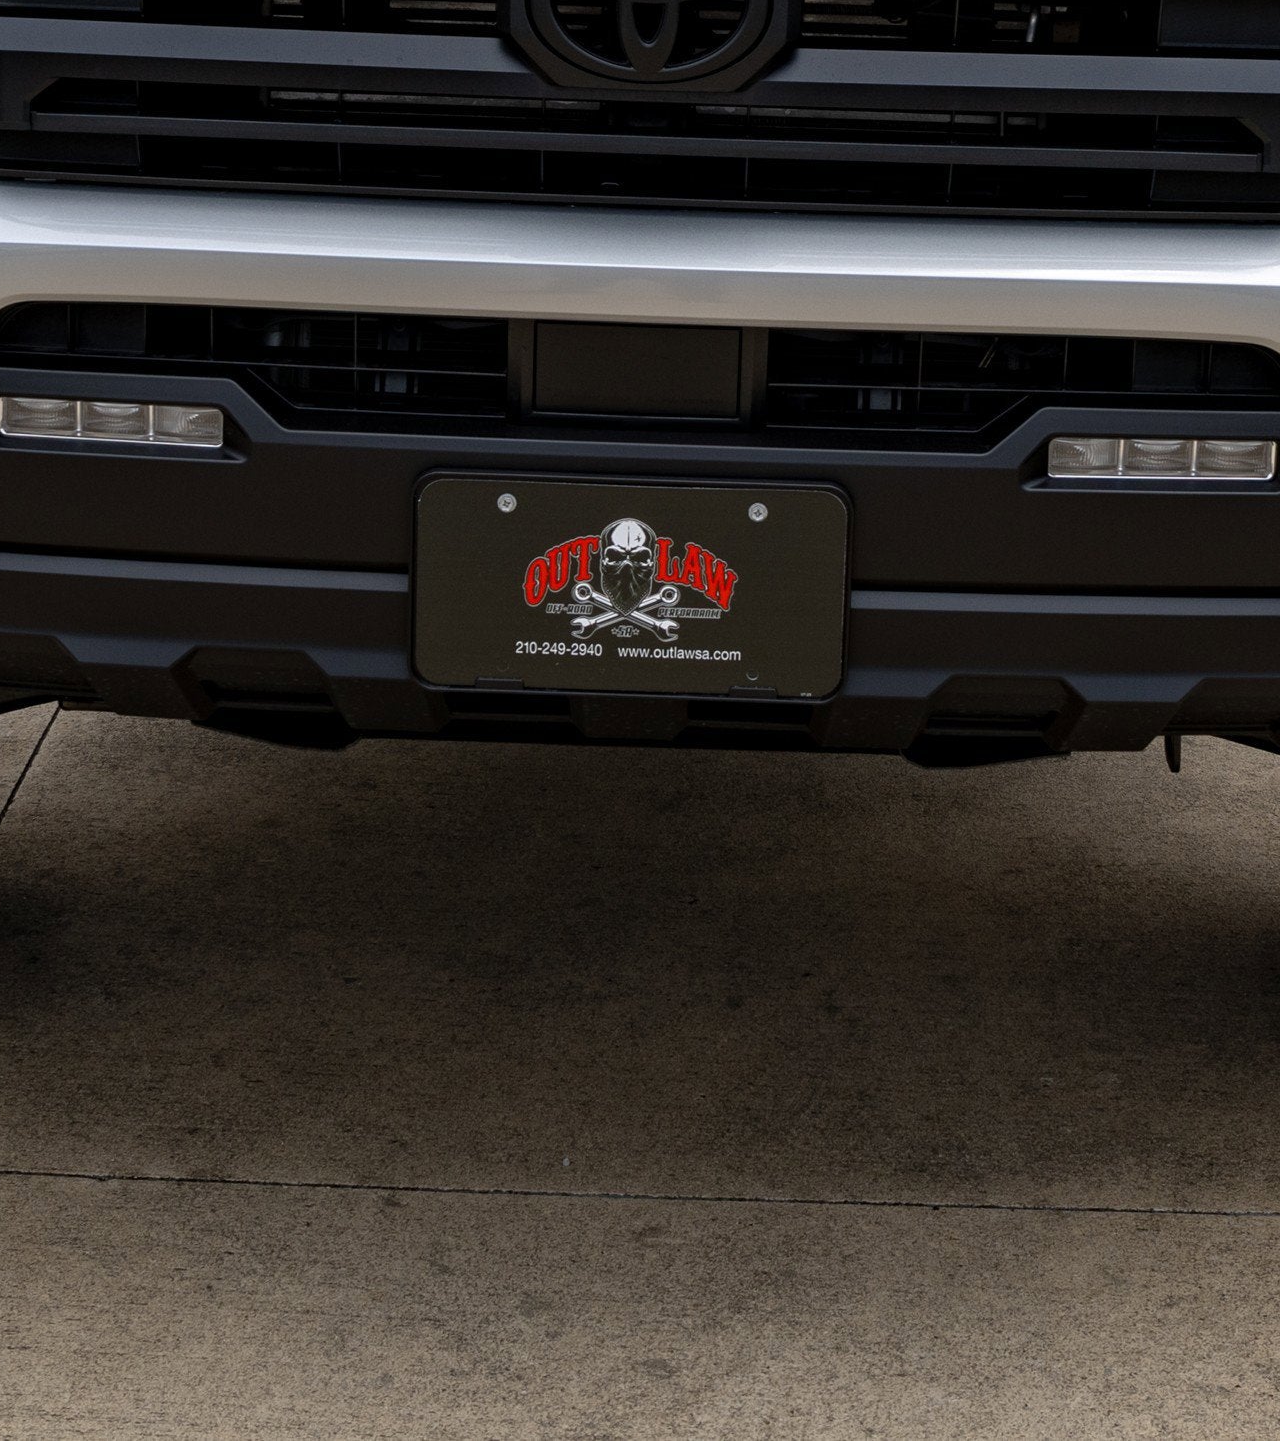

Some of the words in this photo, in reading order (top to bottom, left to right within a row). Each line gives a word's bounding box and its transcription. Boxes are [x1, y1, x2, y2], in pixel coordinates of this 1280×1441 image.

[546, 604, 593, 614] OFF-ROAD
[658, 608, 721, 619] PERFORMANCE
[515, 641, 603, 656] 210-249-2940
[618, 646, 742, 661] www.outlawsa.com
